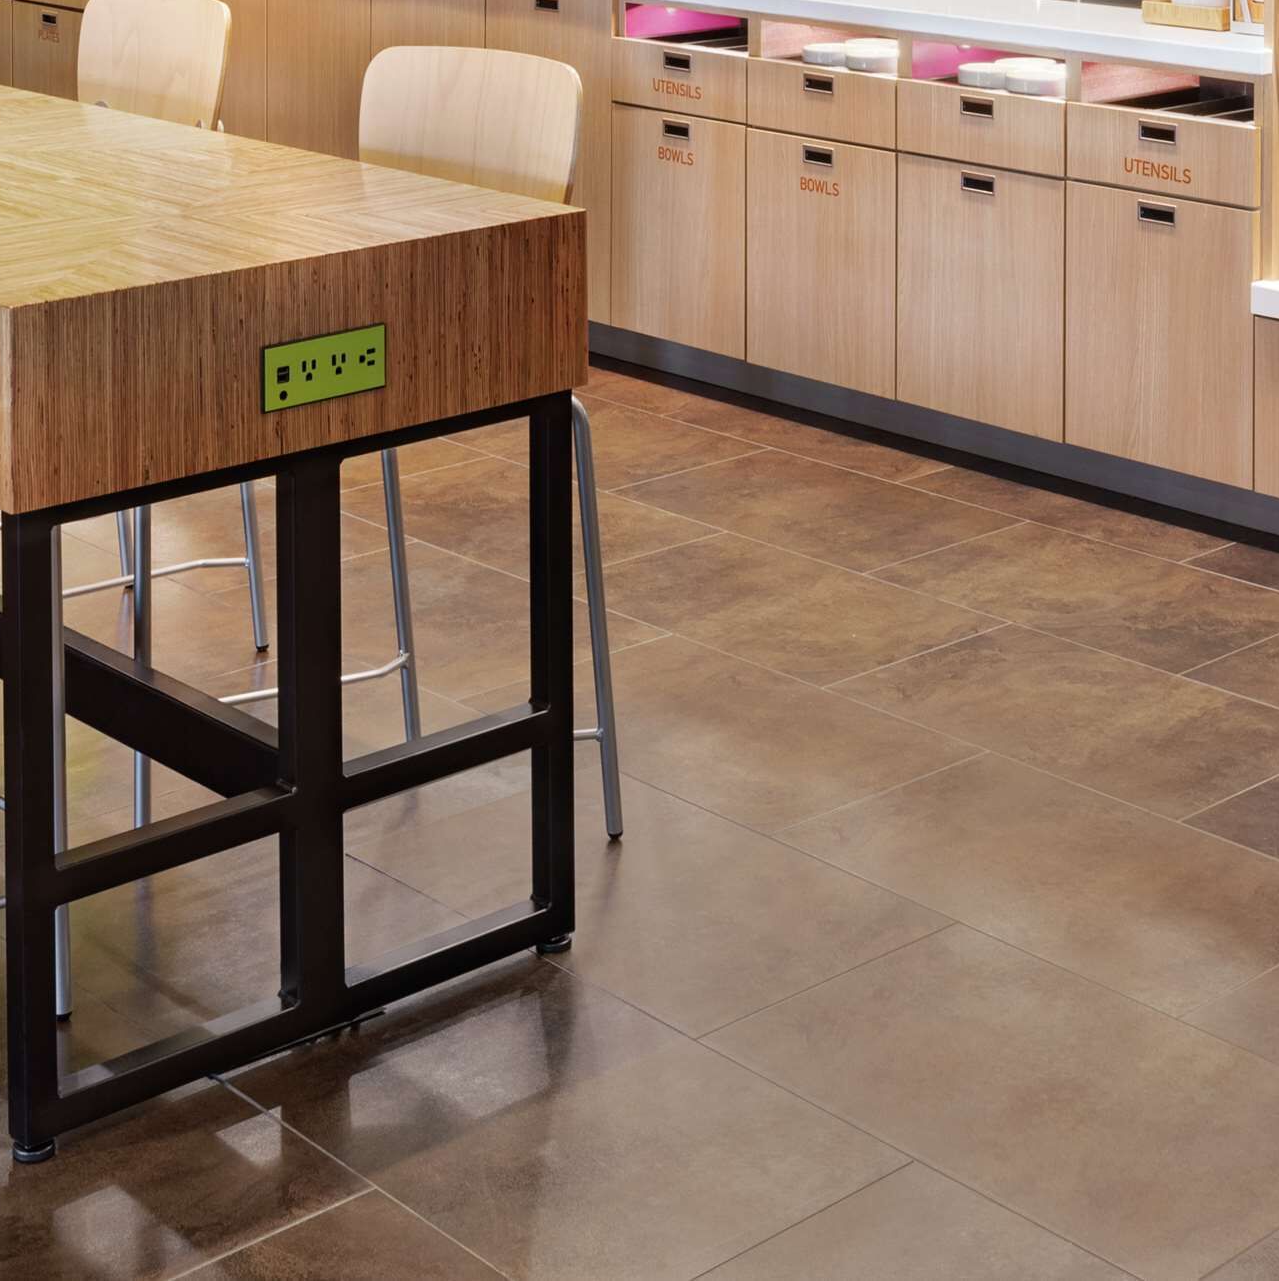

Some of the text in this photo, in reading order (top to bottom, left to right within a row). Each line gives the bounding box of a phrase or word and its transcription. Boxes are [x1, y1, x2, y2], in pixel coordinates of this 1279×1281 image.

[653, 78, 702, 100] UTENSILS
[658, 146, 694, 166] BOWLS
[1124, 157, 1192, 184] UTENSILS
[800, 176, 840, 197] BOWLS
